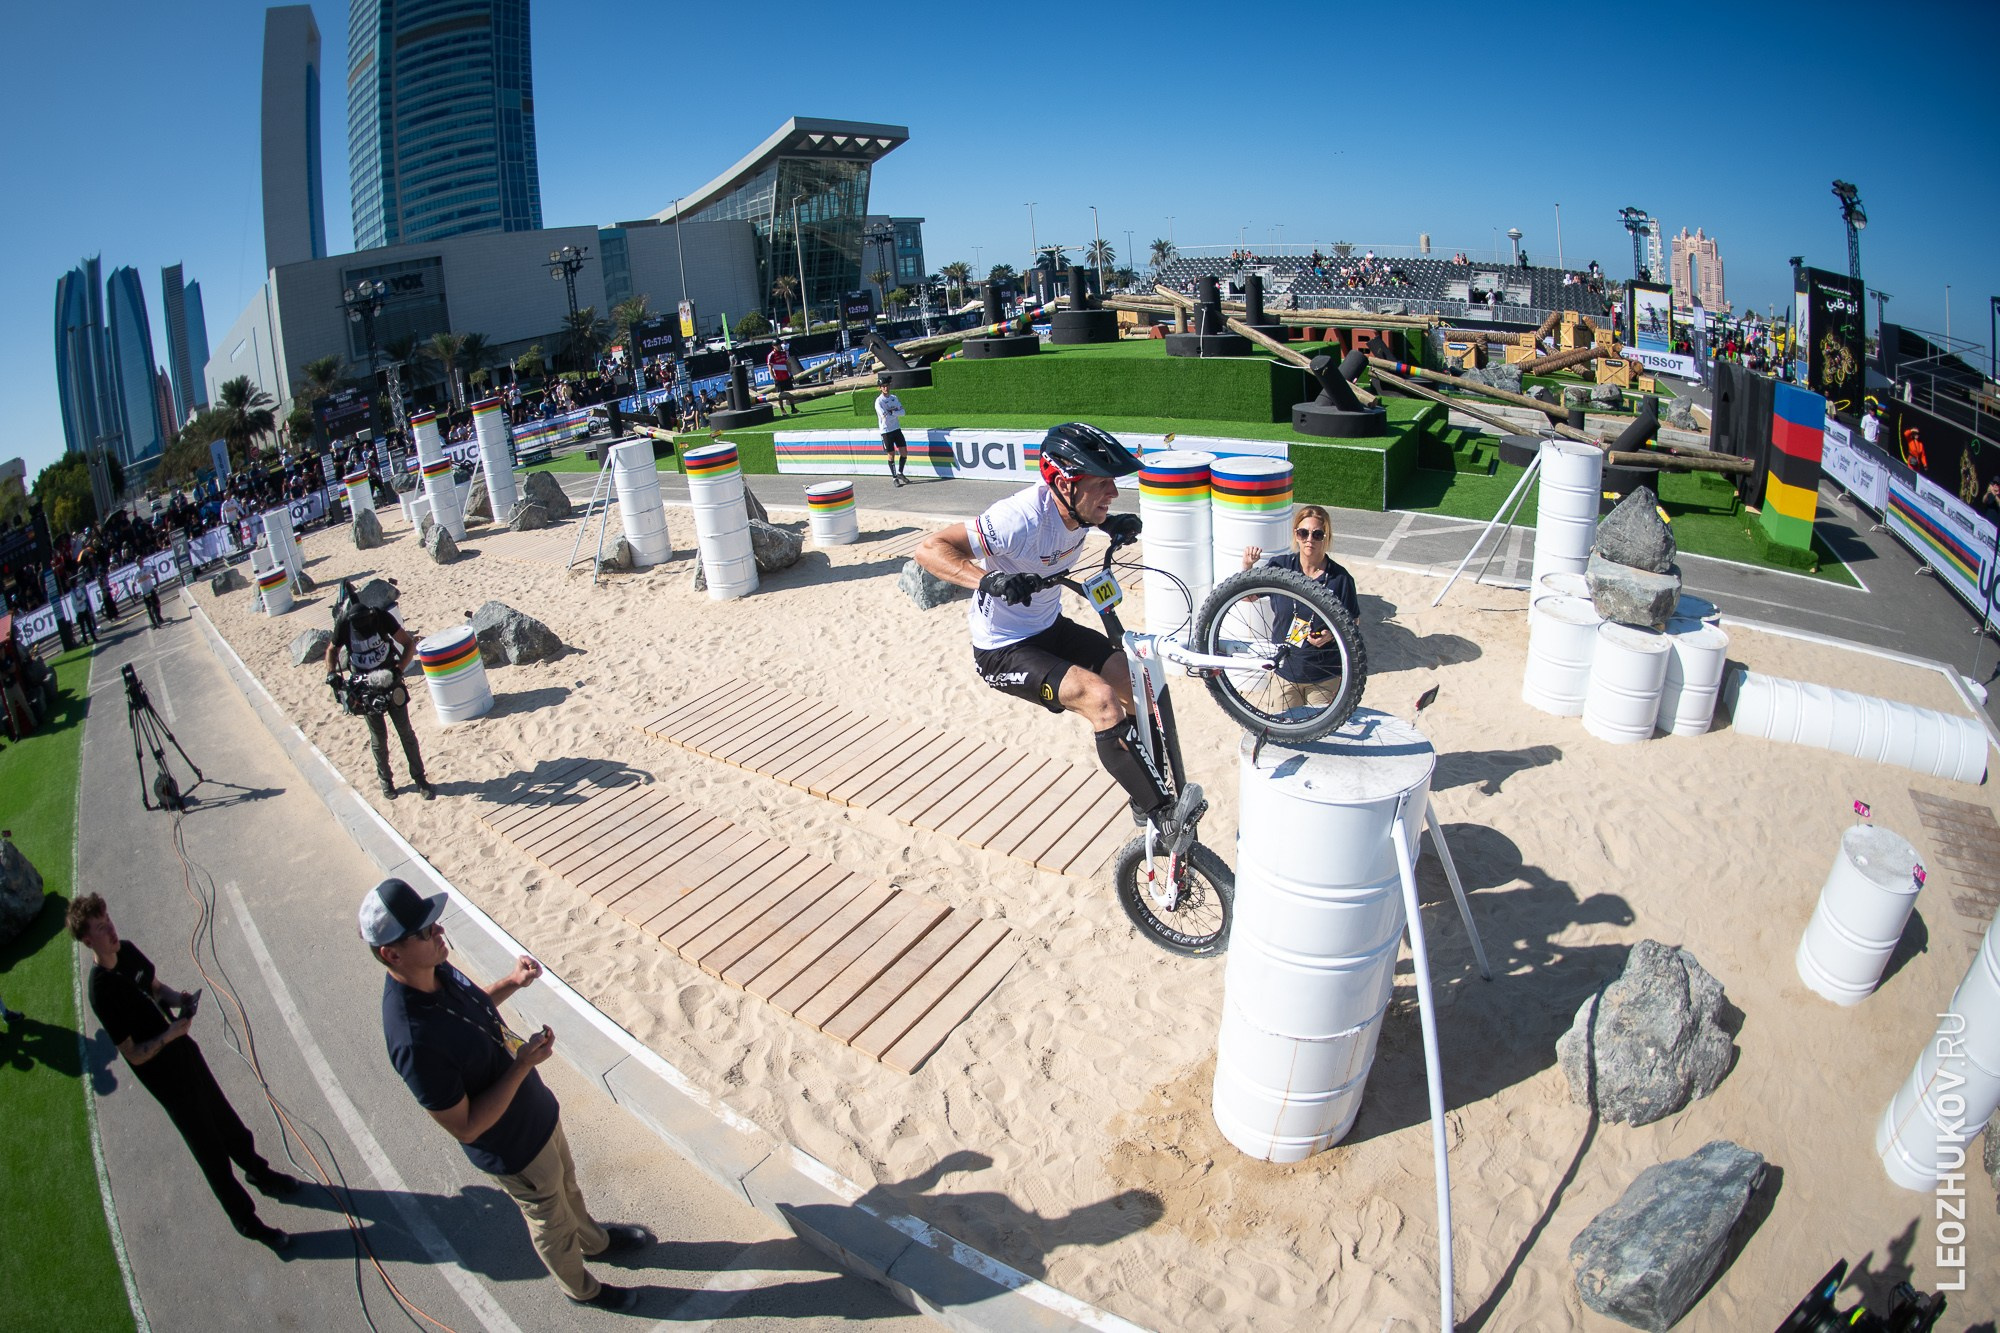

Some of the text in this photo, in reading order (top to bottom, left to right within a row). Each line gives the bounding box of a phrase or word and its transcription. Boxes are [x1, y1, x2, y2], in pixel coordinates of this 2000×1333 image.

[390, 272, 424, 292] VOX
[642, 334, 673, 349] 12:57:50
[1639, 354, 1683, 371] TISSOT
[452, 445, 479, 462] UC
[955, 441, 1016, 471] UCI
[177, 544, 187, 556] 2
[1096, 585, 1113, 602] 121
